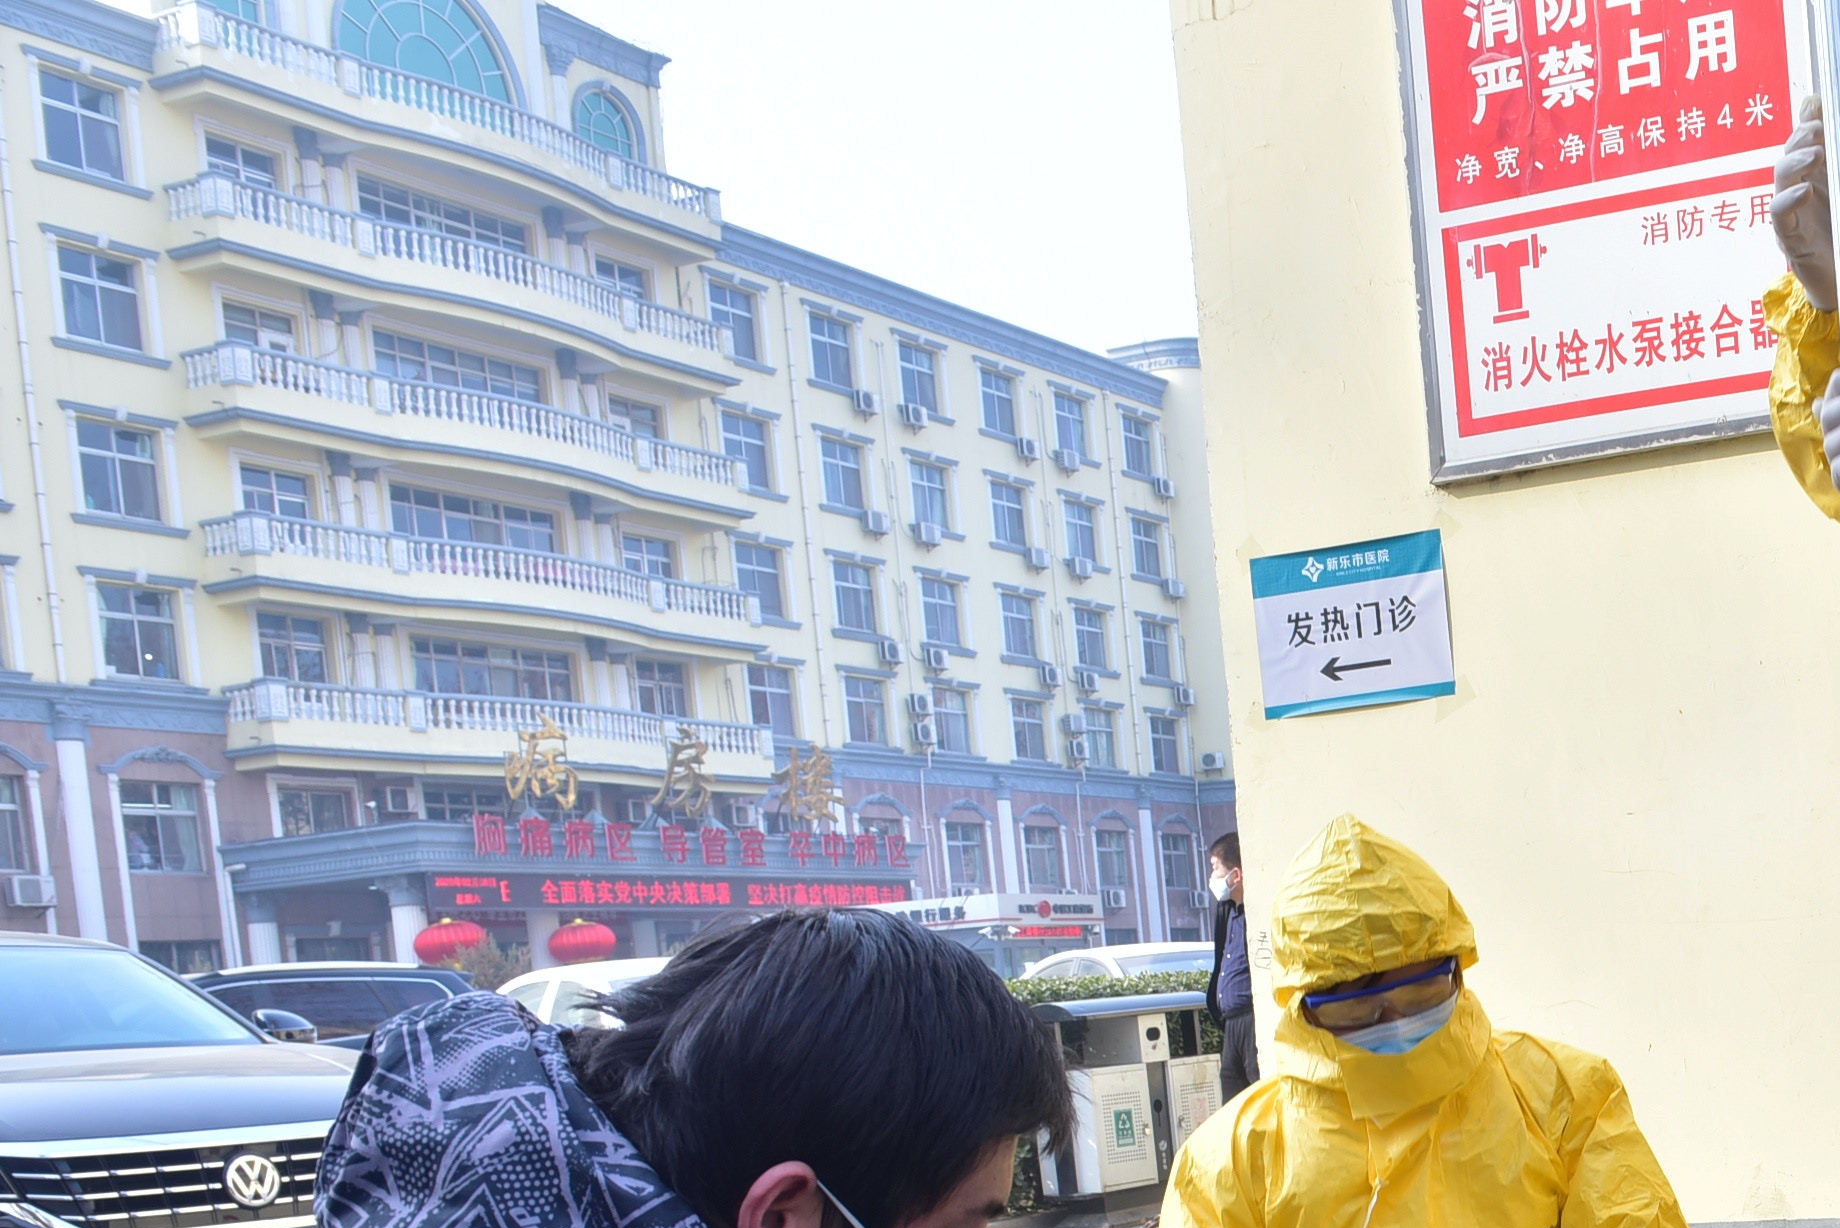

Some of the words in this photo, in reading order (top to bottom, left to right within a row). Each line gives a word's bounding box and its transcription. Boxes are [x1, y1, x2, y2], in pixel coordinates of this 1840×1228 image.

[1471, 9, 1738, 126] 严禁占用
[1455, 93, 1774, 186] 净宽、净高保持4米
[1641, 193, 1775, 246] 消防专用
[1481, 299, 1778, 392] 消火栓水泵接合器
[1326, 549, 1390, 572] 新乐市医院
[1287, 595, 1416, 648] 发热门诊
[473, 813, 638, 862] 胸痛病区
[659, 824, 767, 867] 导管室
[789, 830, 911, 869] 卒中病区
